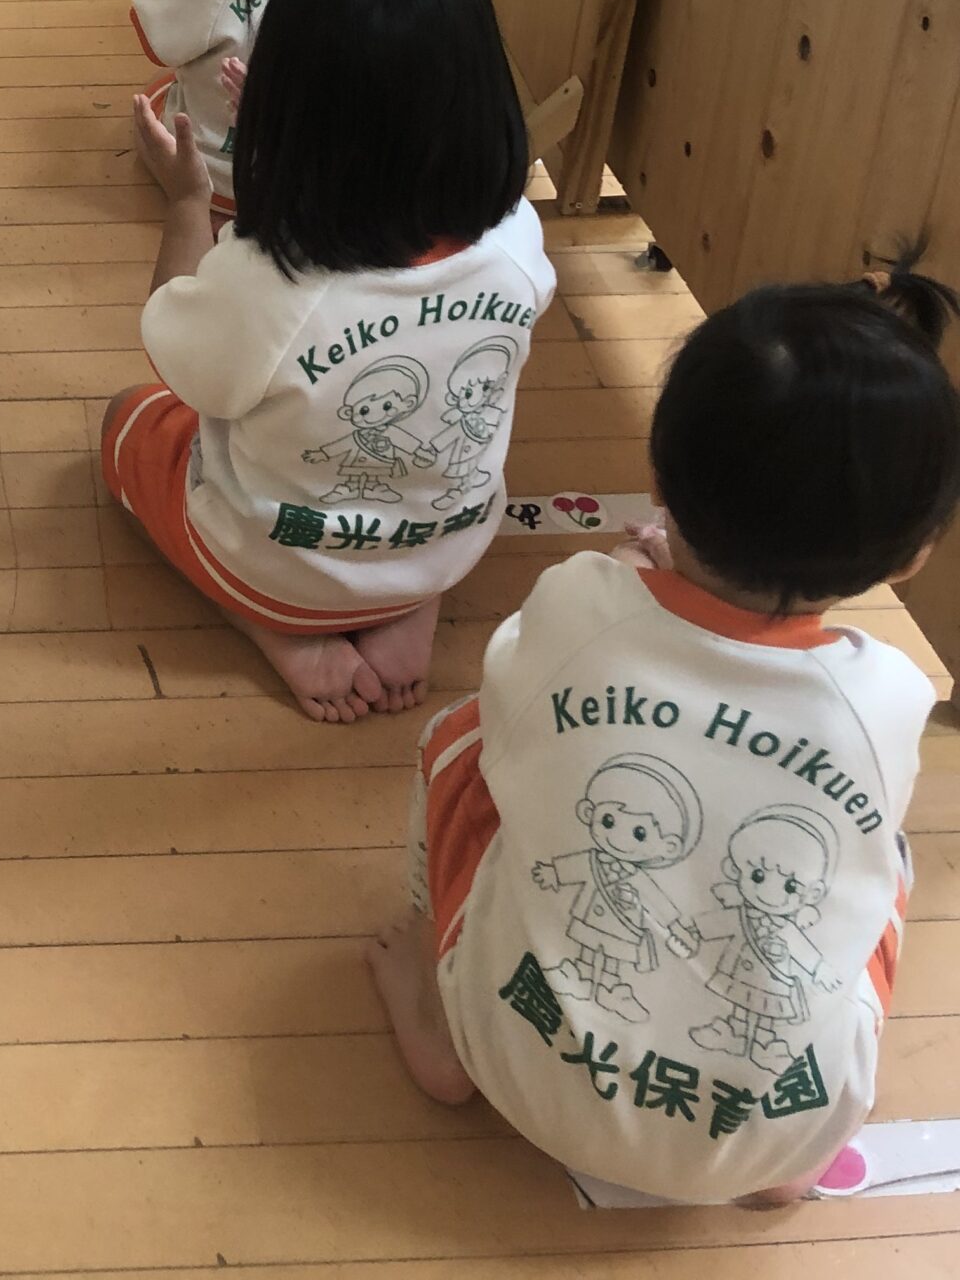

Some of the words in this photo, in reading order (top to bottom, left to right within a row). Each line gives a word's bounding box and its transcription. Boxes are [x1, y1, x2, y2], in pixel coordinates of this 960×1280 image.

[297, 314, 399, 385] Keiko
[417, 291, 536, 330] Hoikue
[552, 685, 680, 735] Keiko
[704, 701, 883, 836] Hoikuen
